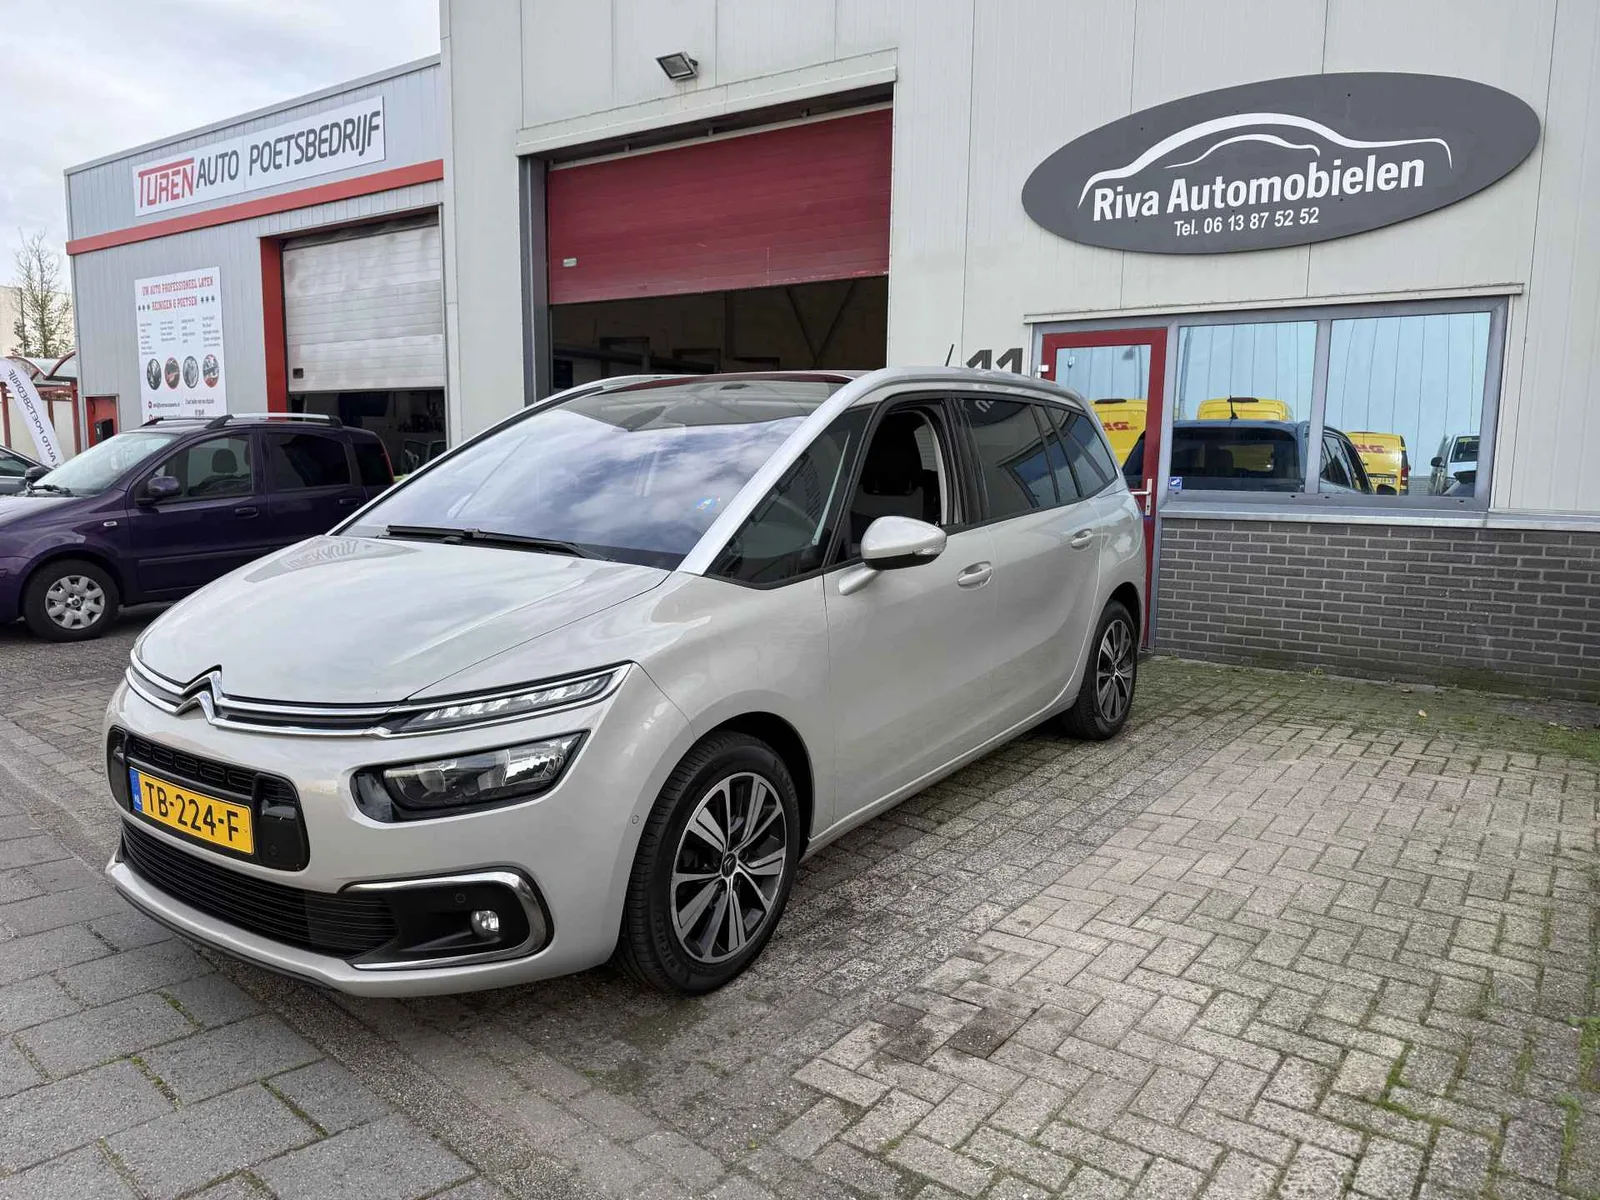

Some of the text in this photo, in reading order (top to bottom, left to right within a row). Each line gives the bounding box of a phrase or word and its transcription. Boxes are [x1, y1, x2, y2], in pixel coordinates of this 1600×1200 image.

[138, 110, 381, 208] TUREN AUTO POETSBEDRIJF
[1093, 154, 1425, 222] Riva Automobielen
[1174, 207, 1320, 237] Tel. 06 13 87 52 52
[966, 347, 1023, 375] 11
[144, 781, 239, 842] TB-224-F
